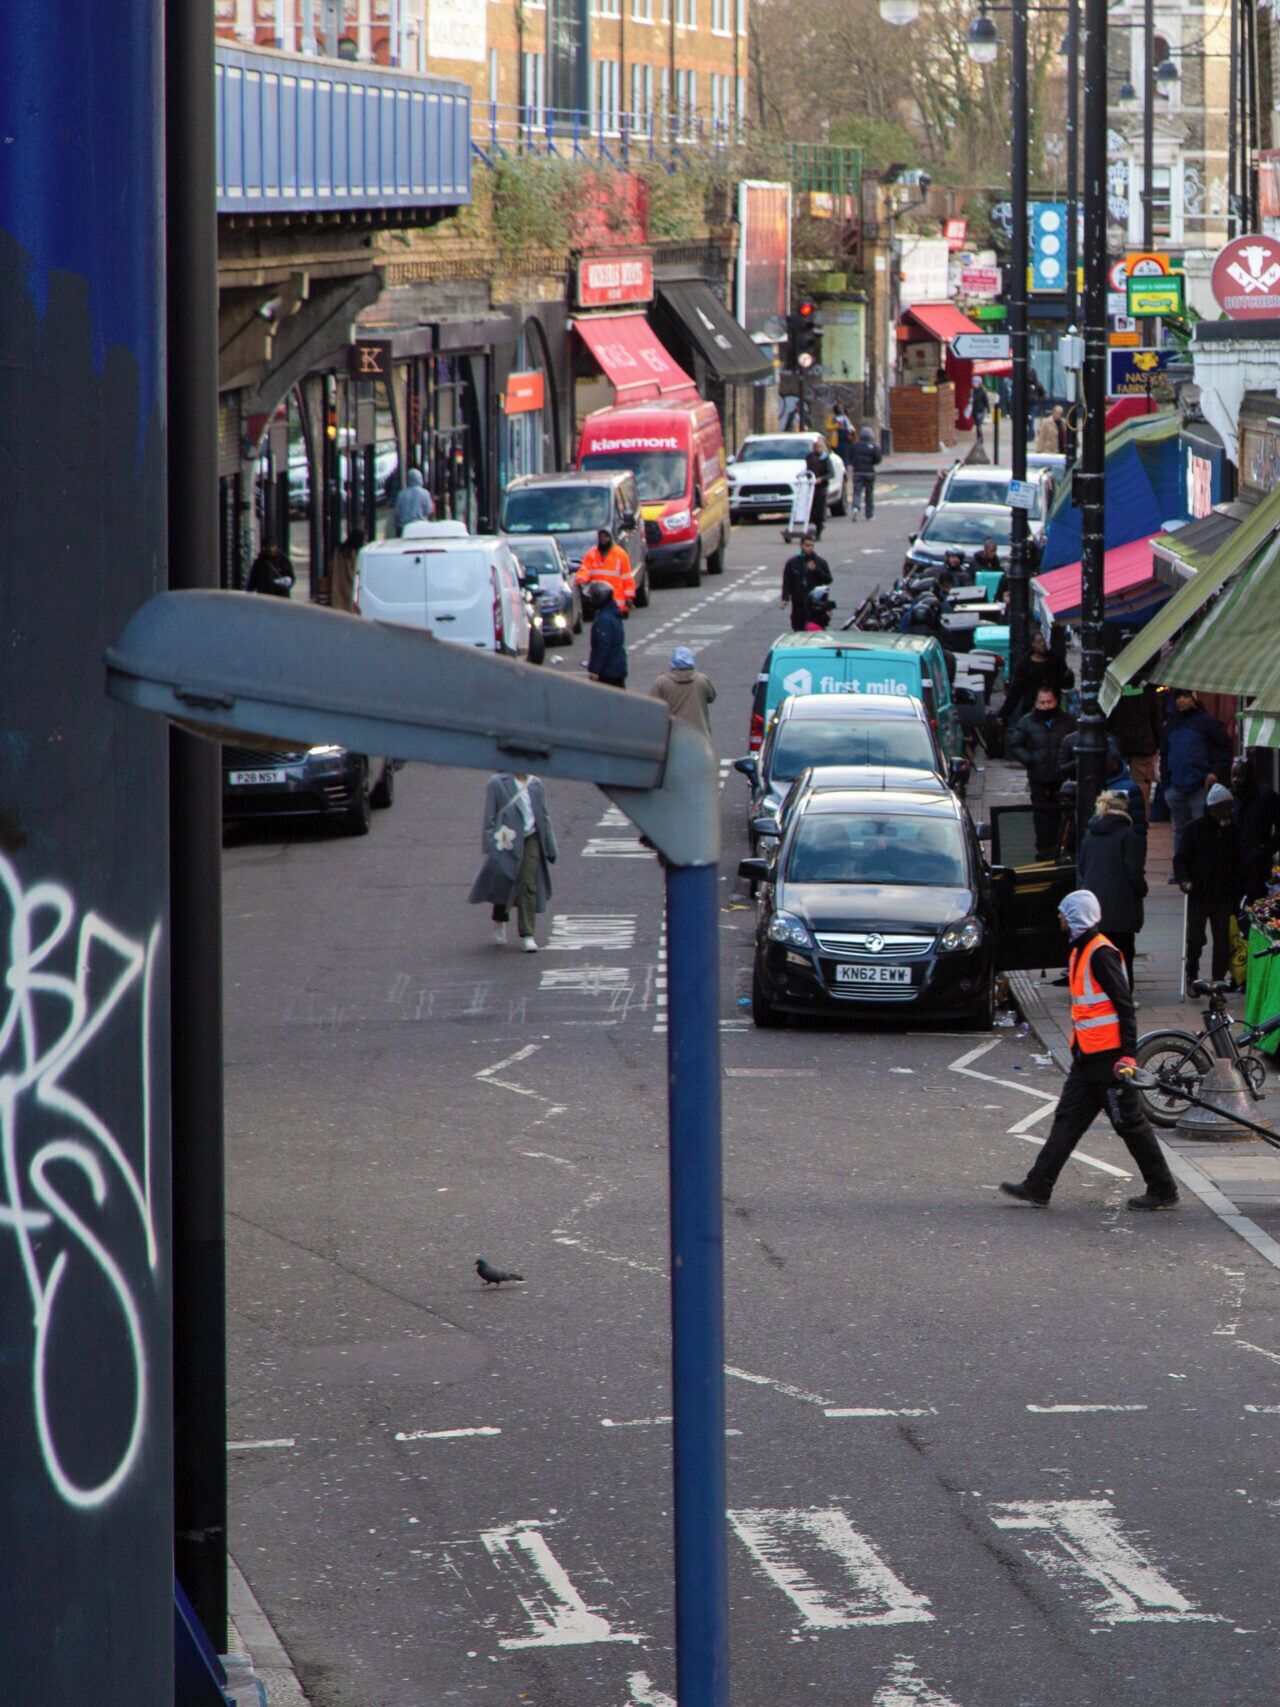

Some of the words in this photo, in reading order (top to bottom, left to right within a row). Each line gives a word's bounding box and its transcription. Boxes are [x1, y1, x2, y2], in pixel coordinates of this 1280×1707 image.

[359, 347, 383, 373] K
[819, 676, 861, 694] first
[866, 678, 908, 695] mile
[258, 771, 278, 783] NSY
[841, 966, 876, 981] KN62
[879, 968, 906, 982] EWW
